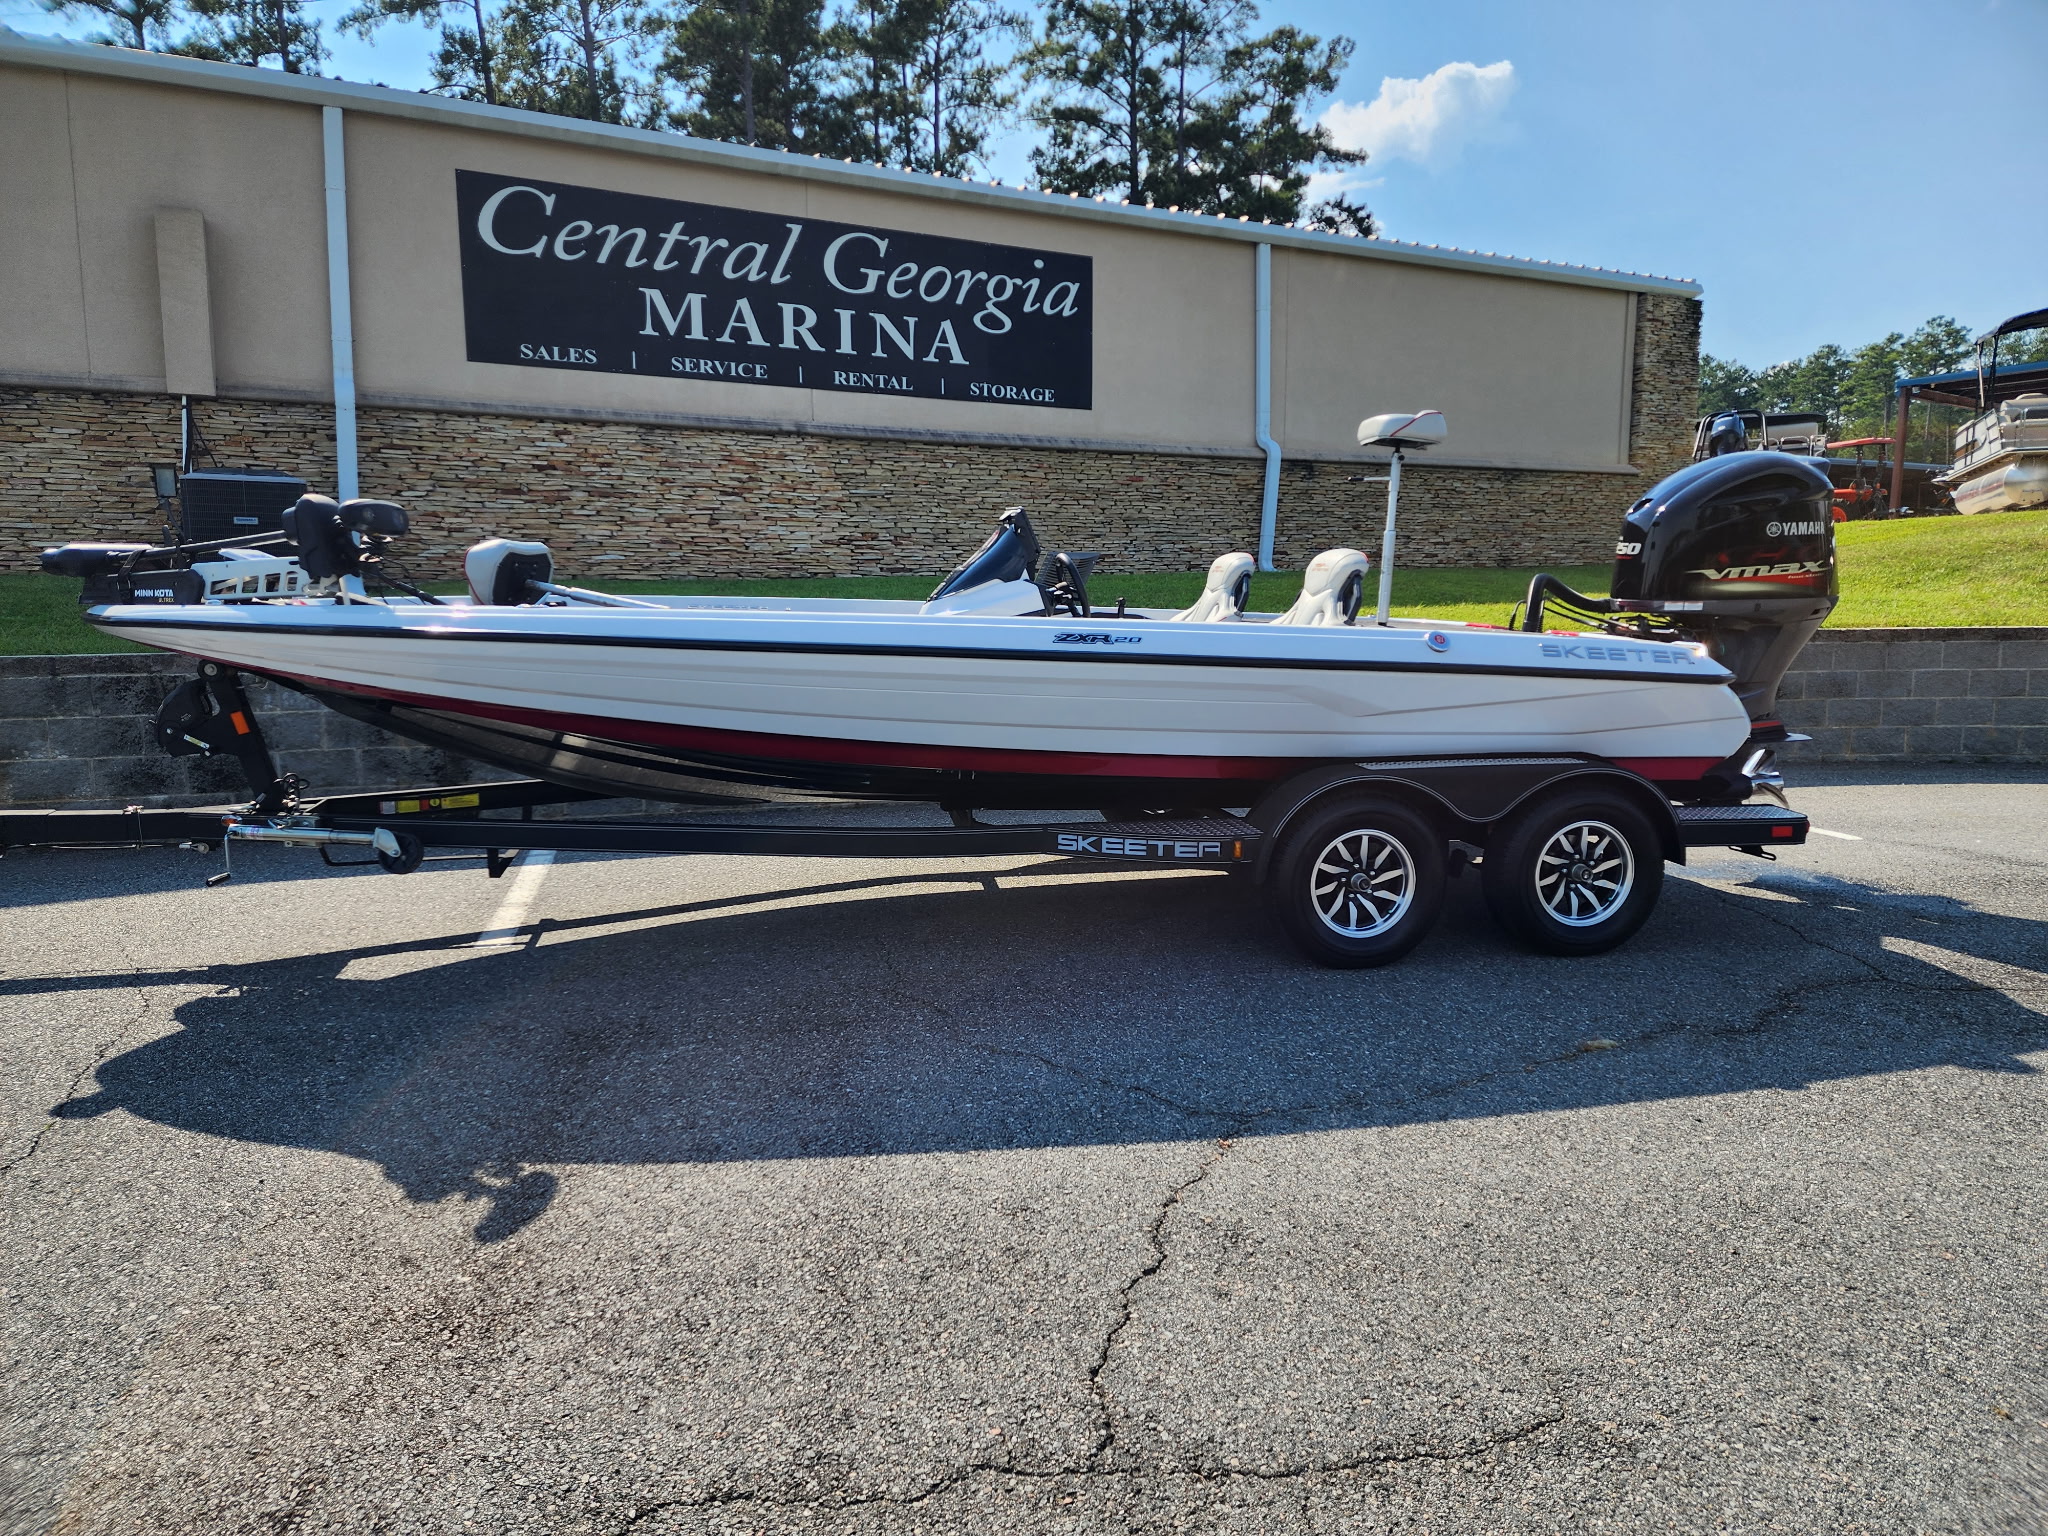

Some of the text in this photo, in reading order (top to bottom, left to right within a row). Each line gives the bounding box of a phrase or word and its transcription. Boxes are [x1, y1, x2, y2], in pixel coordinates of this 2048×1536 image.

[478, 186, 1080, 334] Central Georgia
[639, 287, 970, 365] MARINA
[520, 343, 1055, 402] SALES SERVICE RENTAL STORAGE
[1782, 521, 1825, 536] YAMAHA
[134, 589, 174, 597] MINN KOTA
[1053, 632, 1114, 645] ZXR
[1542, 644, 1692, 665] SKEETER
[1057, 834, 1221, 858] SKEETER
